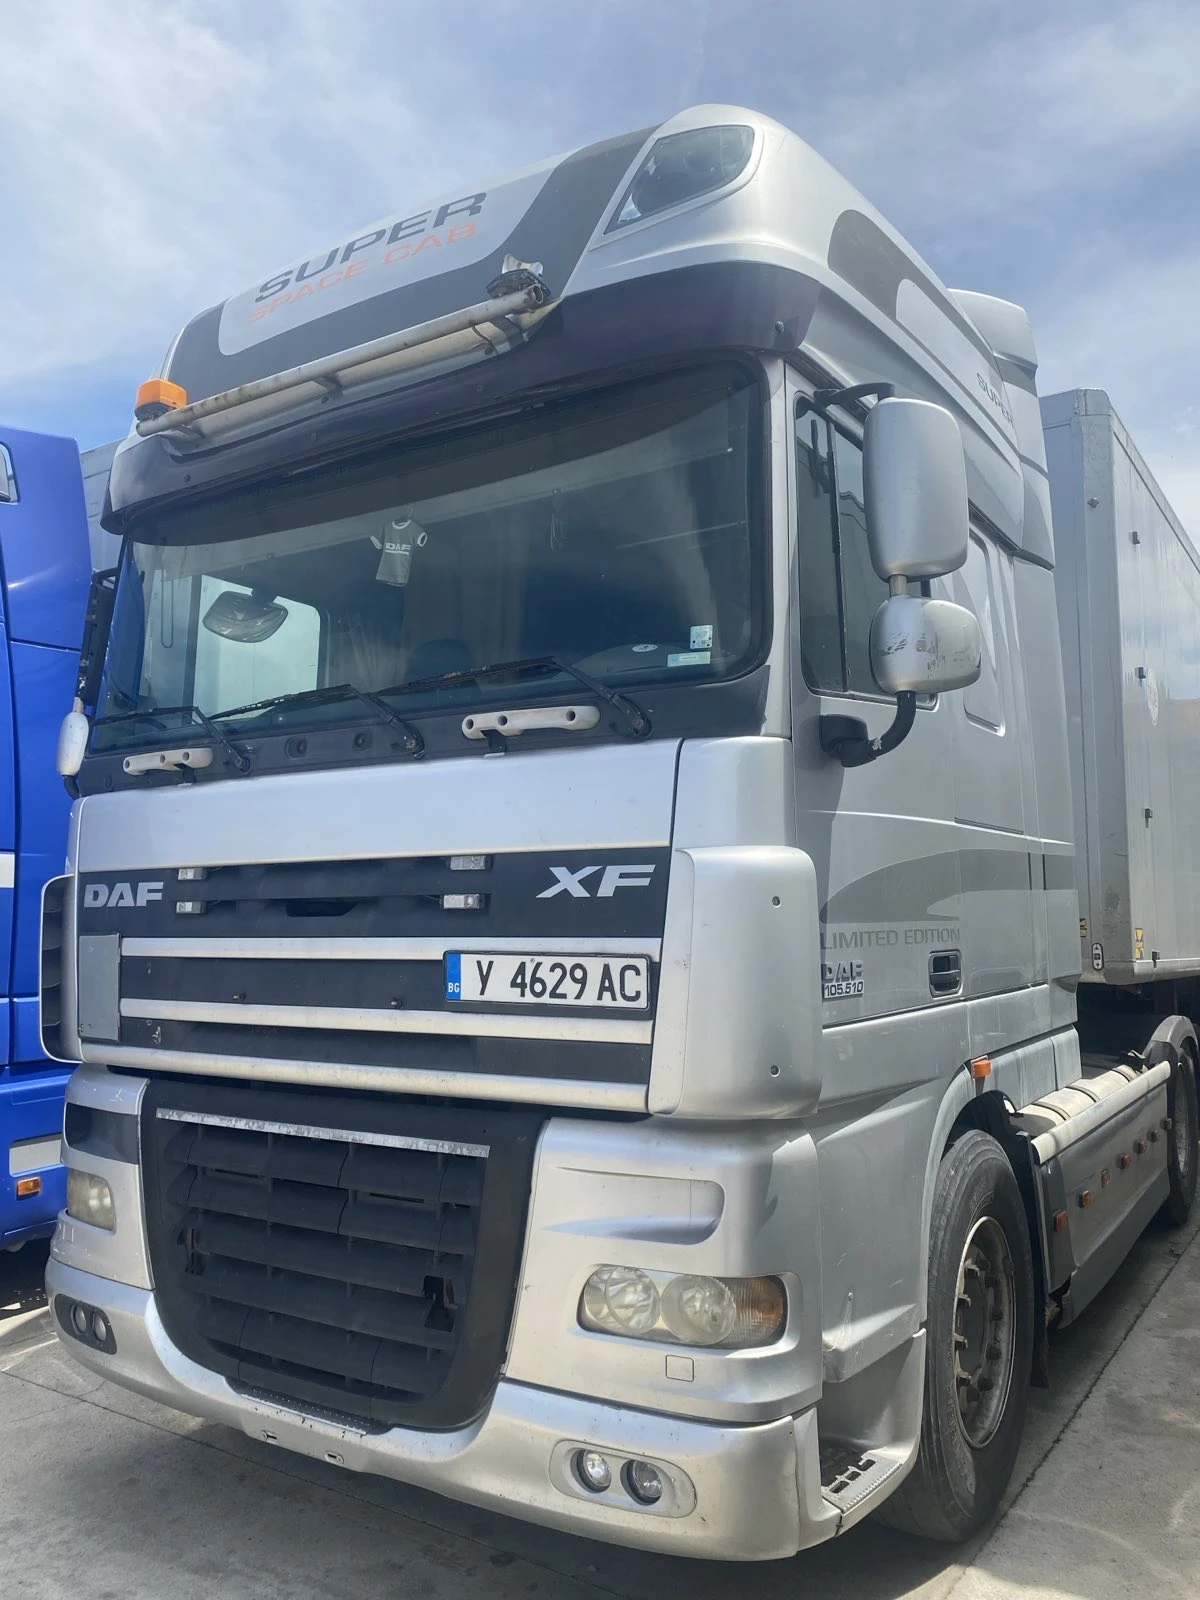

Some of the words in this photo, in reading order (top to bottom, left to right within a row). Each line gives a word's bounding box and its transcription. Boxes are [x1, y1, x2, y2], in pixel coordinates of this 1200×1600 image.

[255, 192, 487, 302] SUPER
[248, 259, 369, 322] SPACE
[384, 223, 478, 265] CAB
[536, 864, 656, 898] XF
[84, 882, 164, 908] DAF
[821, 929, 899, 950] LIMITED
[904, 928, 961, 945] EDITION
[510, 961, 588, 999] 4629
[597, 963, 641, 1002] AC
[822, 960, 864, 982] DAF
[448, 982, 460, 993] BG
[824, 982, 864, 997] 105.510
